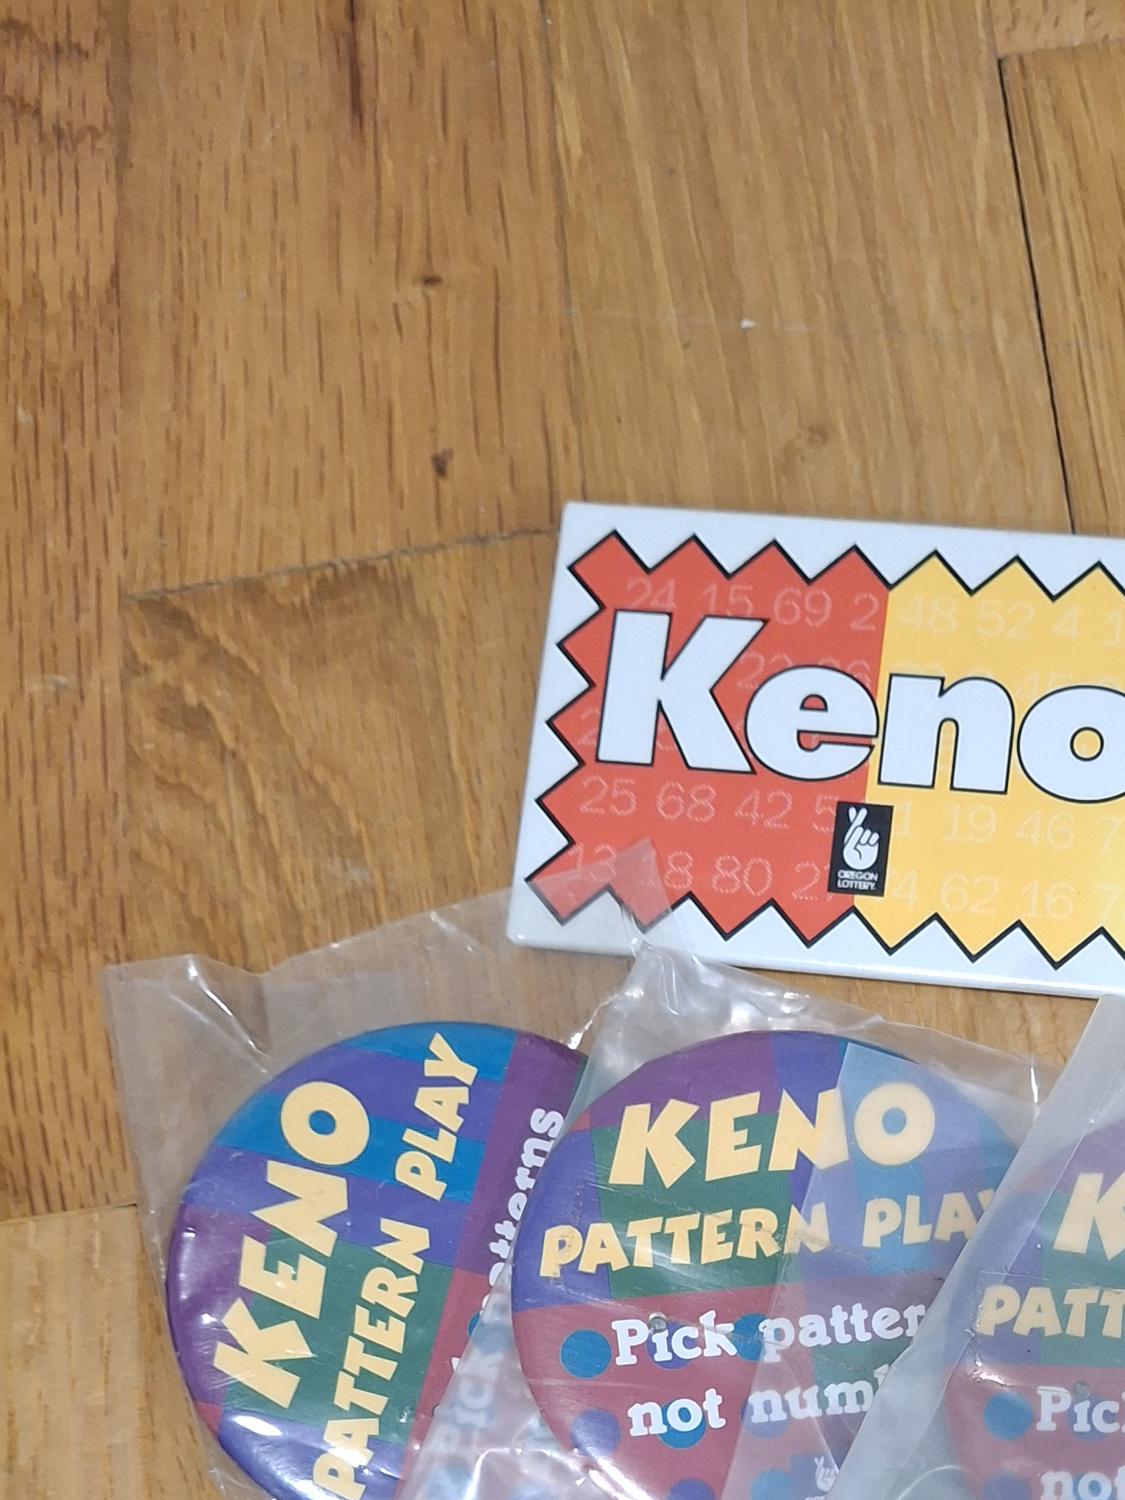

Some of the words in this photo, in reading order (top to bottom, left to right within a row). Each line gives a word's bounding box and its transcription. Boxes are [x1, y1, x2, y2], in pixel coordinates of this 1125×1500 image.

[703, 582, 754, 618] 15
[773, 586, 832, 627] 69
[850, 592, 880, 632] 2
[1051, 606, 1083, 642] 4
[579, 776, 637, 816] 25
[657, 781, 716, 822] 68
[734, 791, 794, 830] 42
[1014, 811, 1076, 850] 46
[712, 855, 773, 897] 80
[940, 873, 999, 914] 62
[1019, 880, 1075, 921] 16
[836, 868, 879, 883] OREGON
[395, 1032, 479, 1201] PLAY
[607, 1082, 936, 1190] KENO
[213, 1080, 370, 1409] KENO
[539, 1204, 831, 1279] PATTERN
[611, 1309, 738, 1366] Pick
[627, 1388, 727, 1438] not
